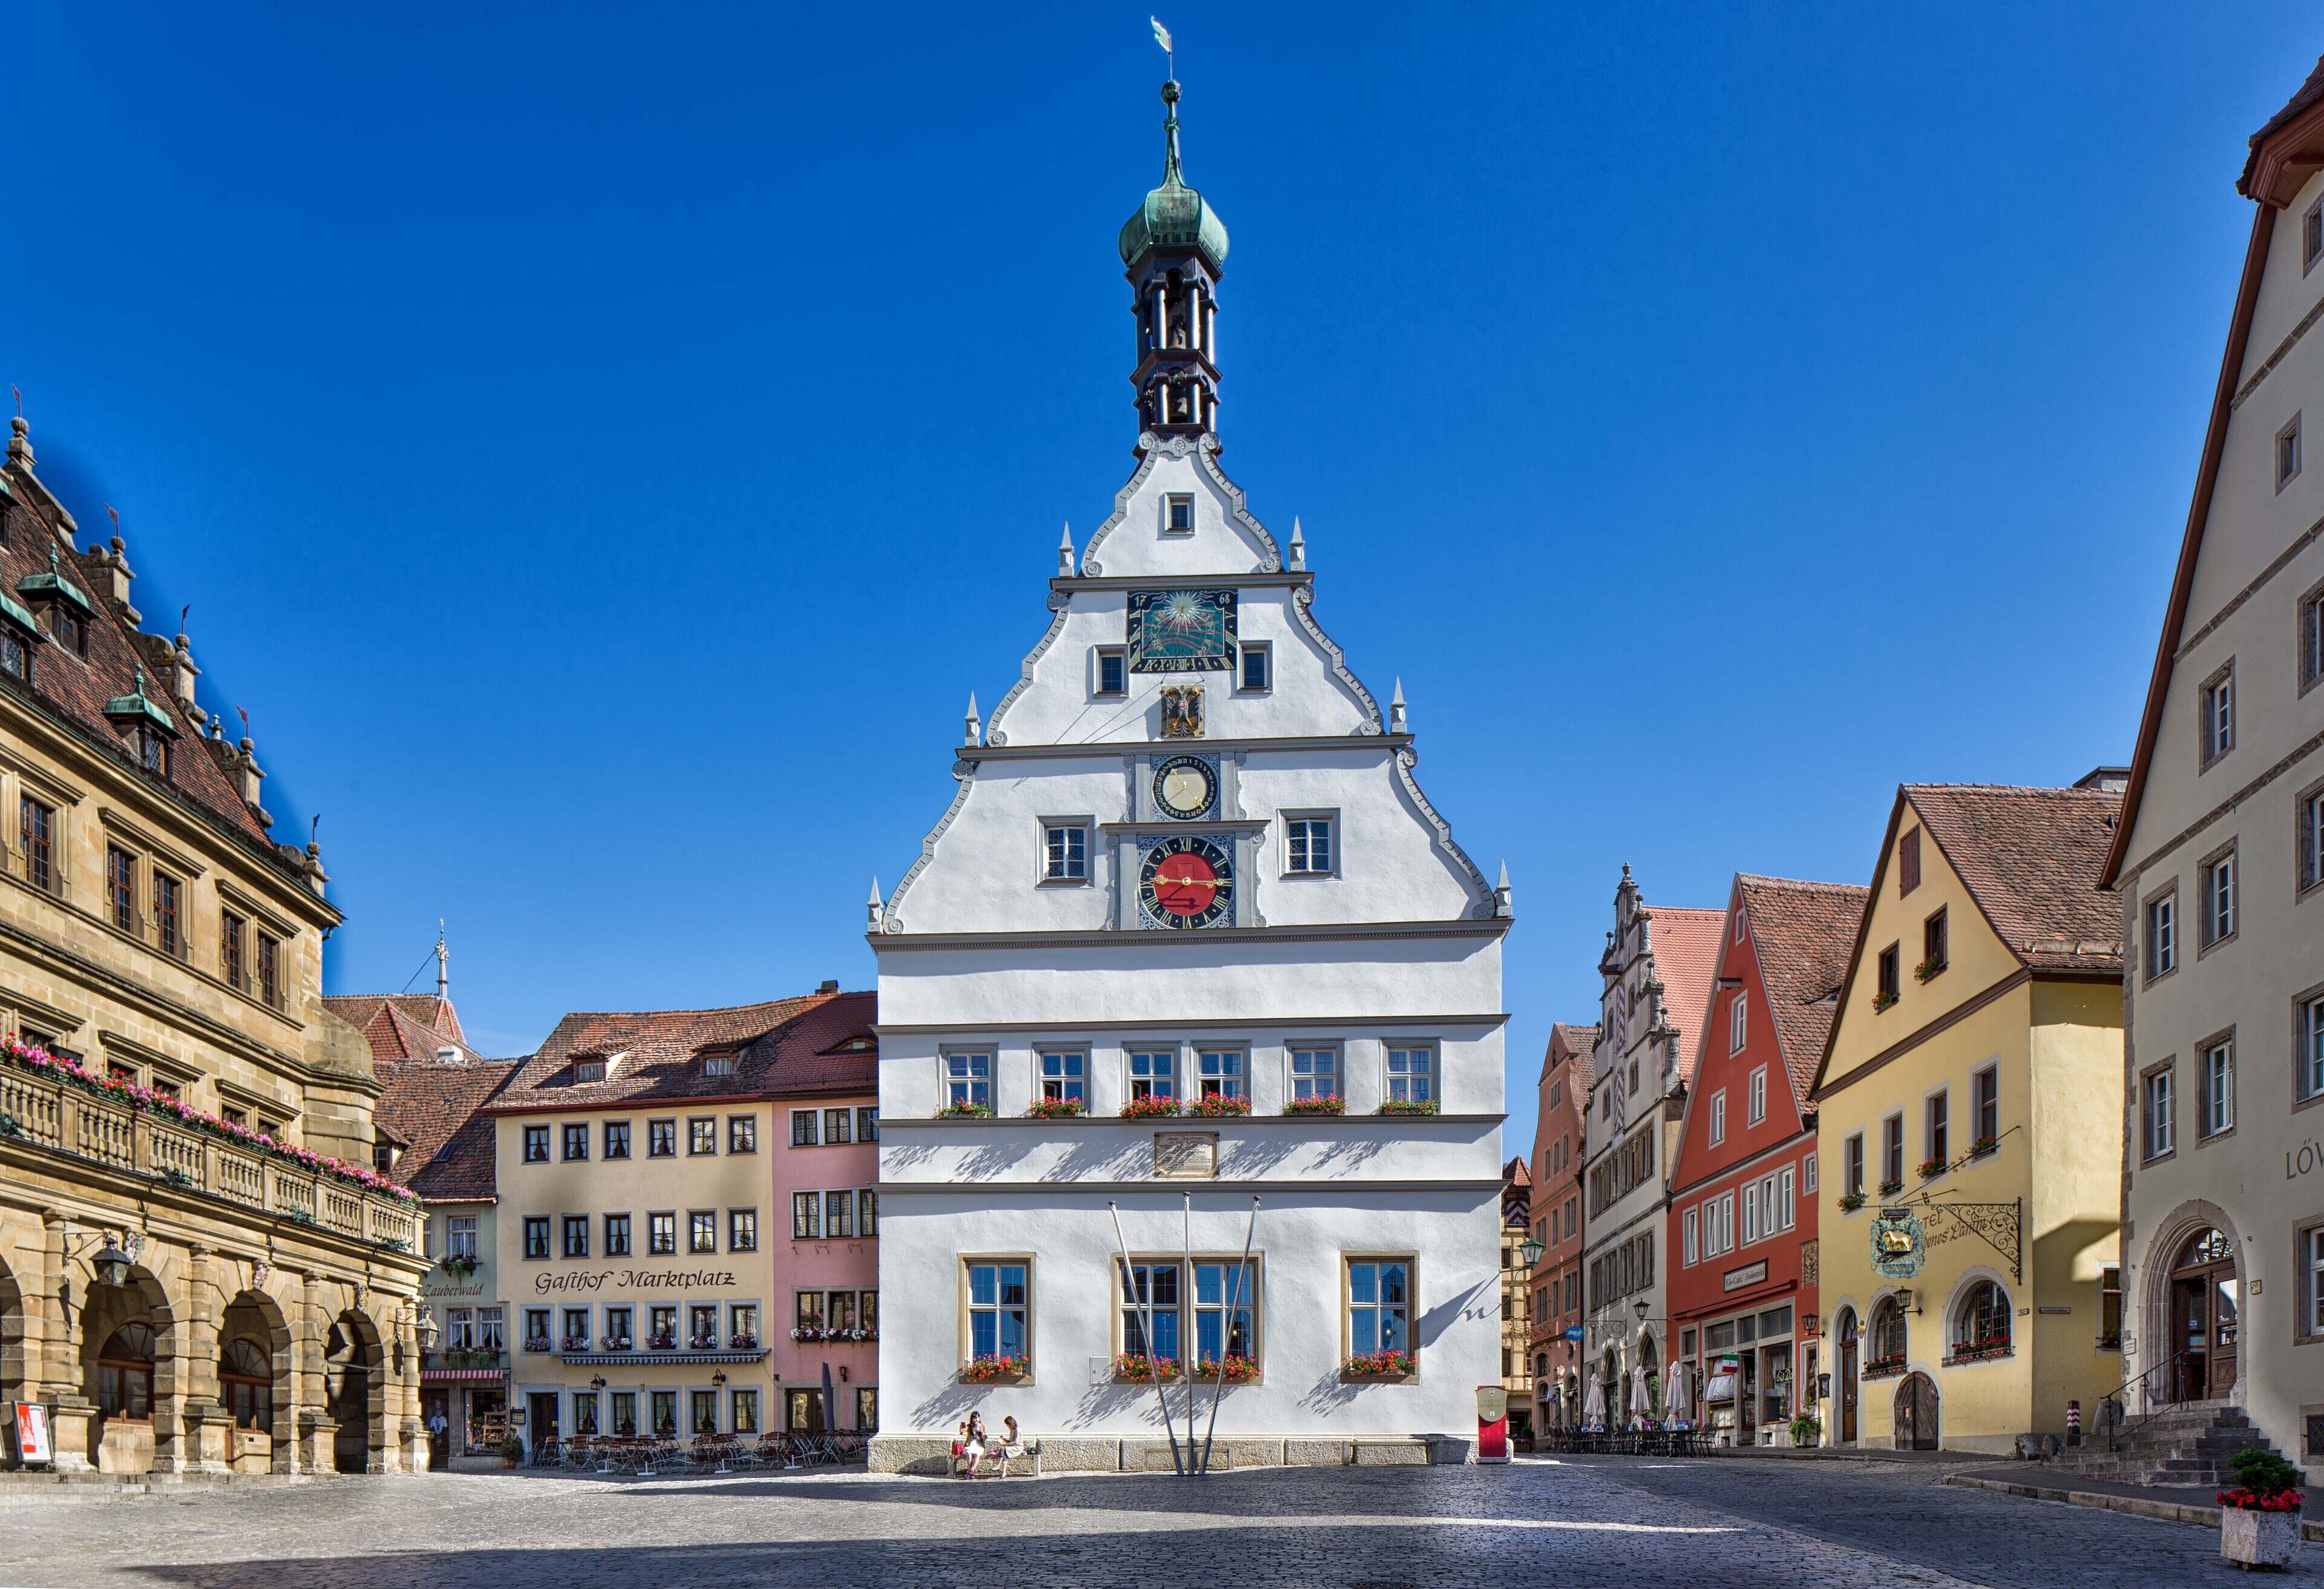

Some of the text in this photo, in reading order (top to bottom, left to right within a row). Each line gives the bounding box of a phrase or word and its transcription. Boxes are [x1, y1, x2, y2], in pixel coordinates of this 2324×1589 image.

[1135, 593, 1230, 607] 17 68
[1157, 659, 1167, 671] X
[1201, 657, 1213, 669] II
[1159, 843, 1173, 858] XI
[1179, 838, 1192, 852] XII
[1201, 843, 1210, 856] I
[1145, 859, 1159, 870] X
[1213, 858, 1227, 869] II
[1212, 895, 1229, 910] IIII
[1202, 911, 1211, 923] V
[1922, 1212, 1943, 1229] TEL
[1924, 1228, 1949, 1248] denes
[617, 1269, 737, 1290] Marktplatz
[1745, 1266, 1765, 1281] Dolomiti
[423, 1283, 484, 1297] Zauberwald
